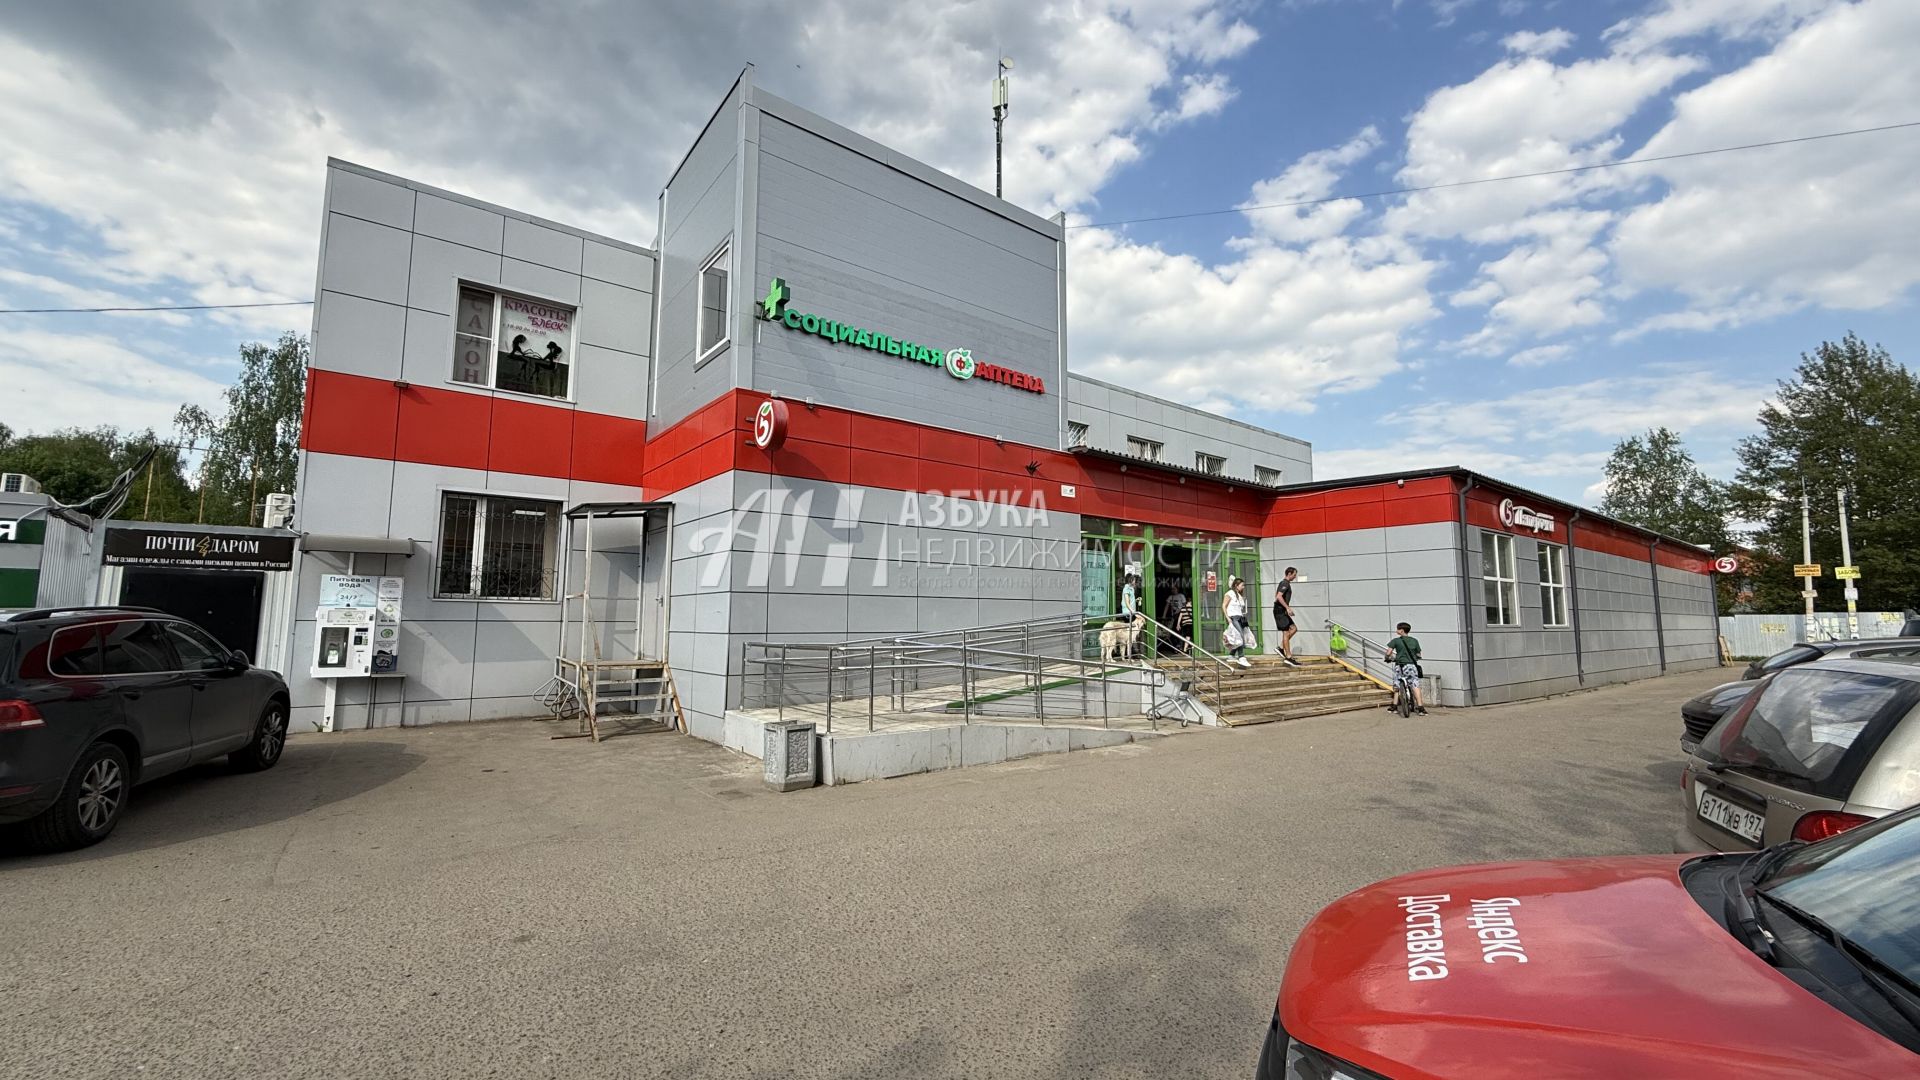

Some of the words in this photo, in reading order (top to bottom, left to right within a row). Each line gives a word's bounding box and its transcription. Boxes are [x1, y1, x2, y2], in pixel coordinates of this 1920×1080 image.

[504, 300, 569, 323] КРАСОТЫ
[464, 299, 484, 383] САЛОН
[784, 308, 945, 368] СОЦИАЛЬНАЯ
[975, 361, 1046, 395] АПТЕКА
[106, 554, 138, 564] Магазин
[139, 557, 170, 565] одежды
[176, 558, 204, 566] самыми
[265, 560, 291, 569] России!
[145, 535, 196, 551] ПОЧТИ
[209, 538, 260, 555] ДАРОМ
[330, 576, 371, 584] Питьевая
[1398, 894, 1451, 981] Доставка
[1466, 897, 1529, 964] Яндекс
